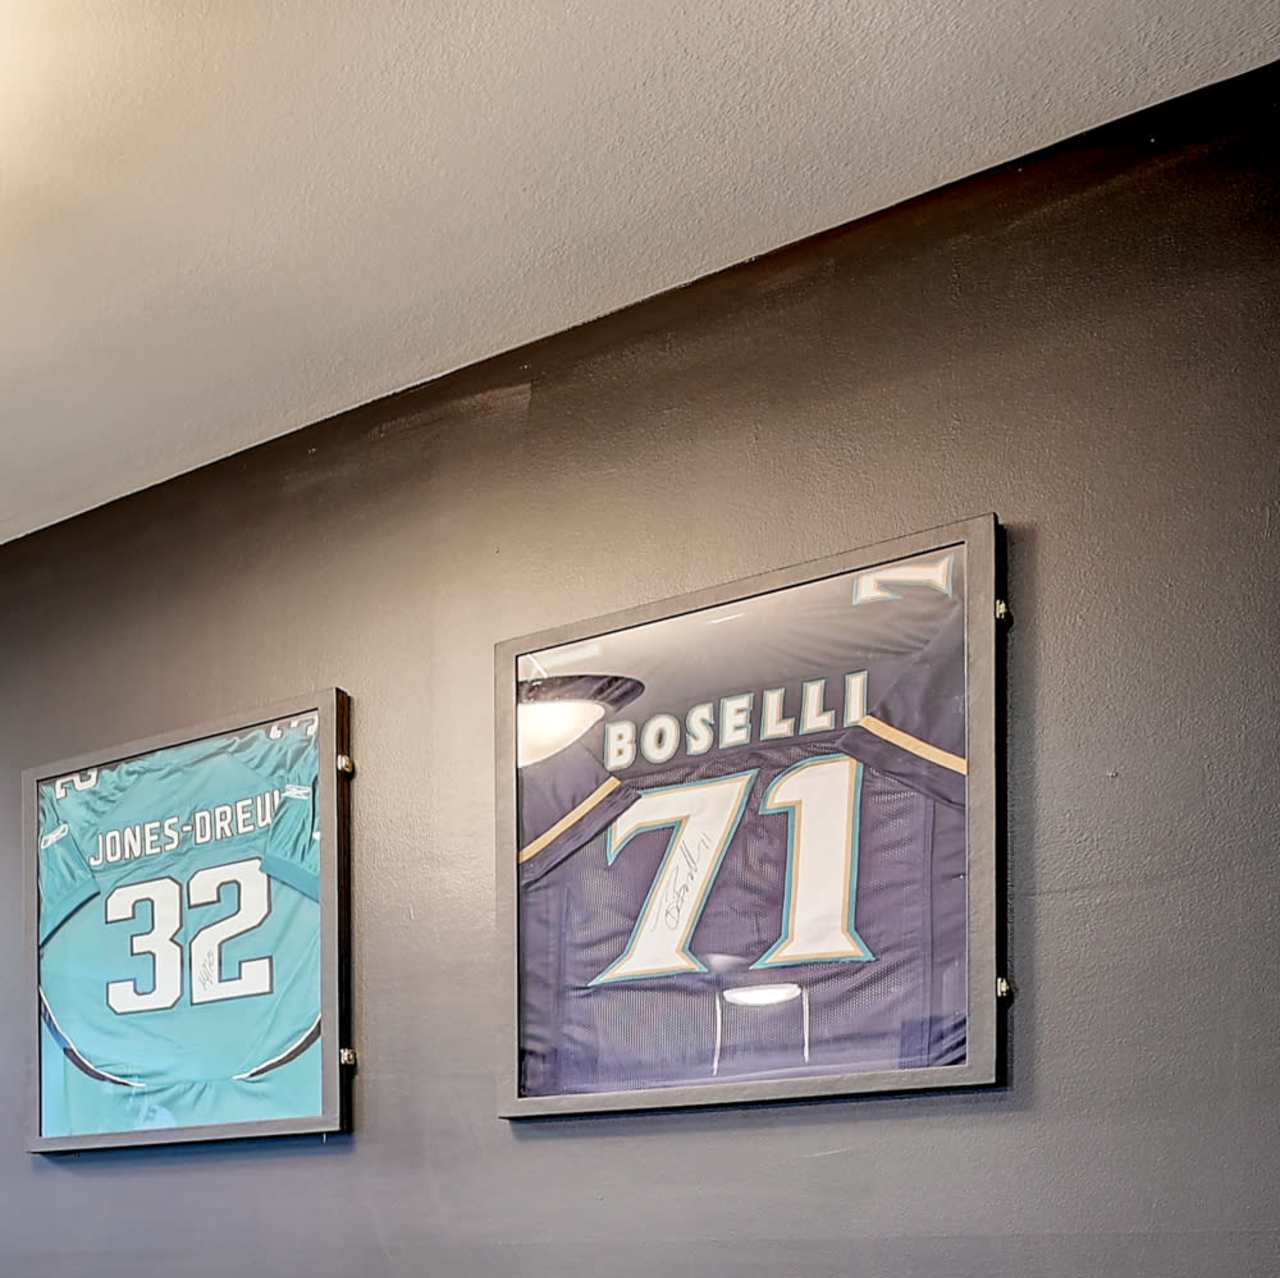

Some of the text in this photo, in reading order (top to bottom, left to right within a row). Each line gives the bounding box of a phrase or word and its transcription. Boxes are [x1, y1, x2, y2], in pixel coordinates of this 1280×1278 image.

[603, 669, 869, 772] BOSELLI
[105, 856, 275, 1016] 32
[587, 752, 877, 987] 71
